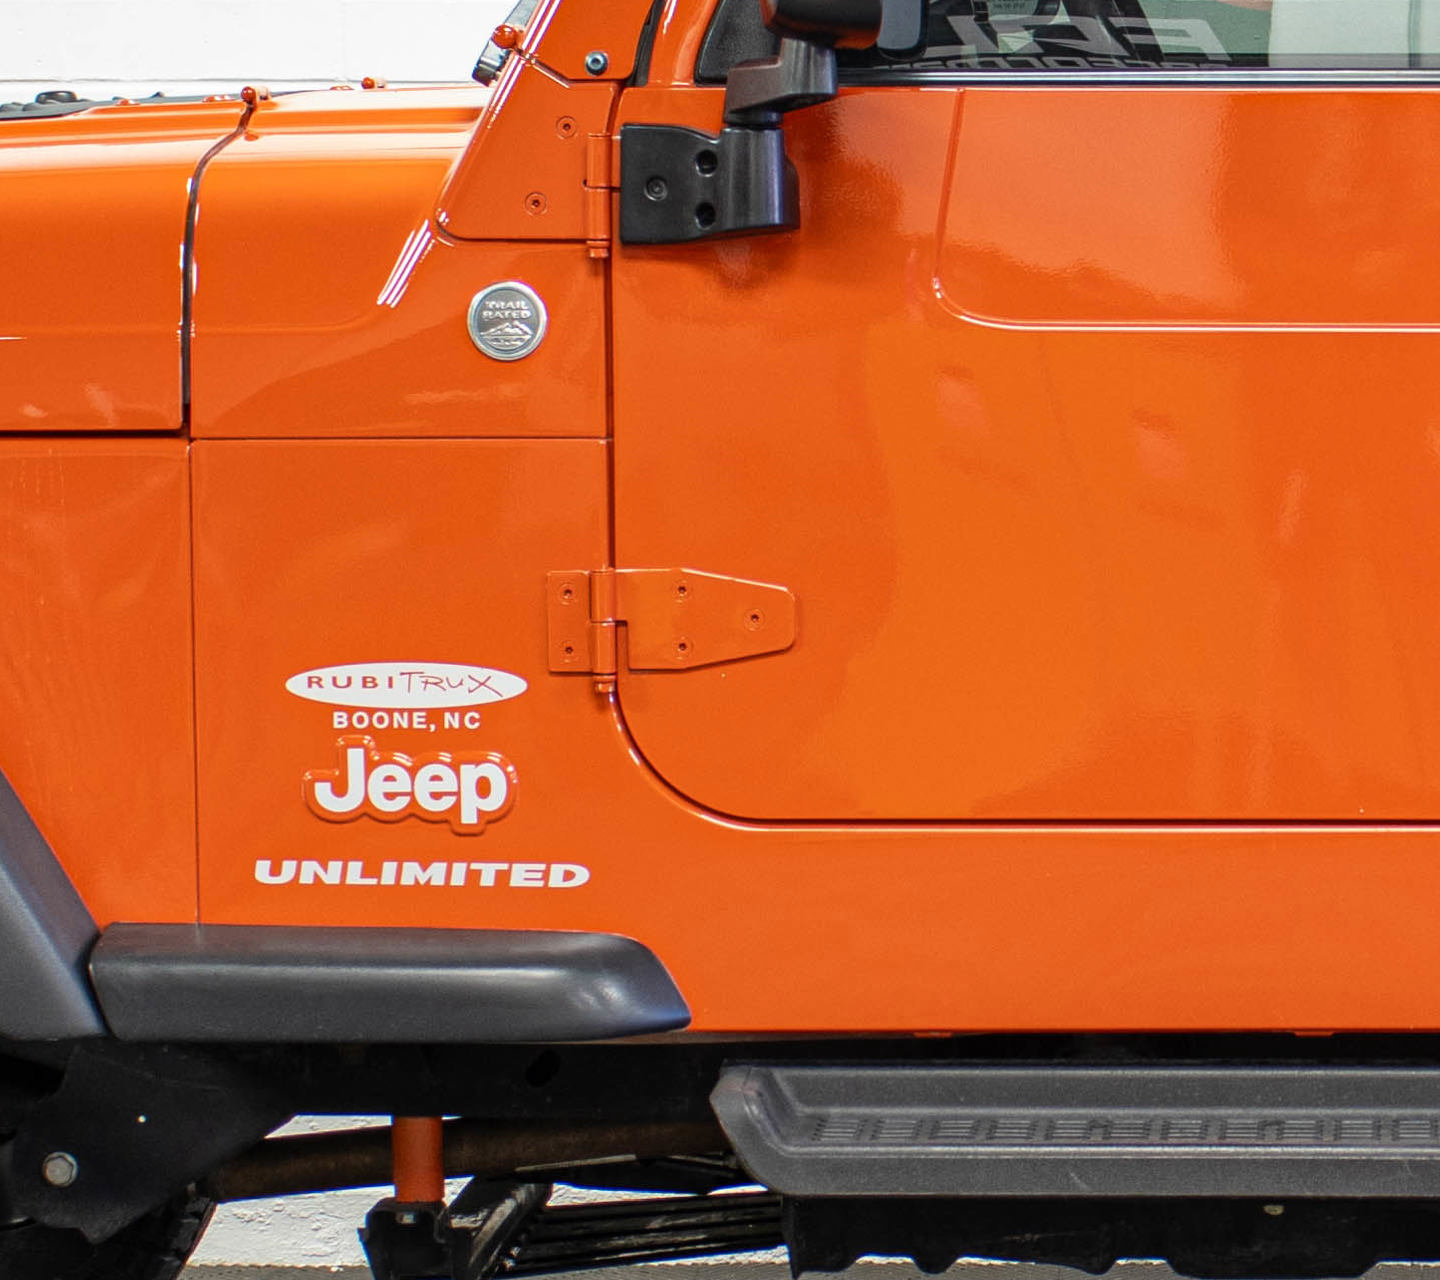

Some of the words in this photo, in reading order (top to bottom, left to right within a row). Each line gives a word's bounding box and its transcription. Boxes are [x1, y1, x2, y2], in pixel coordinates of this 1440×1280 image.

[486, 300, 529, 309] TRAIL
[482, 311, 531, 320] RATED
[333, 712, 437, 731] BOONE,
[443, 712, 481, 729] NC
[314, 748, 507, 824] Jeep
[255, 860, 591, 888] UNLIMITED
